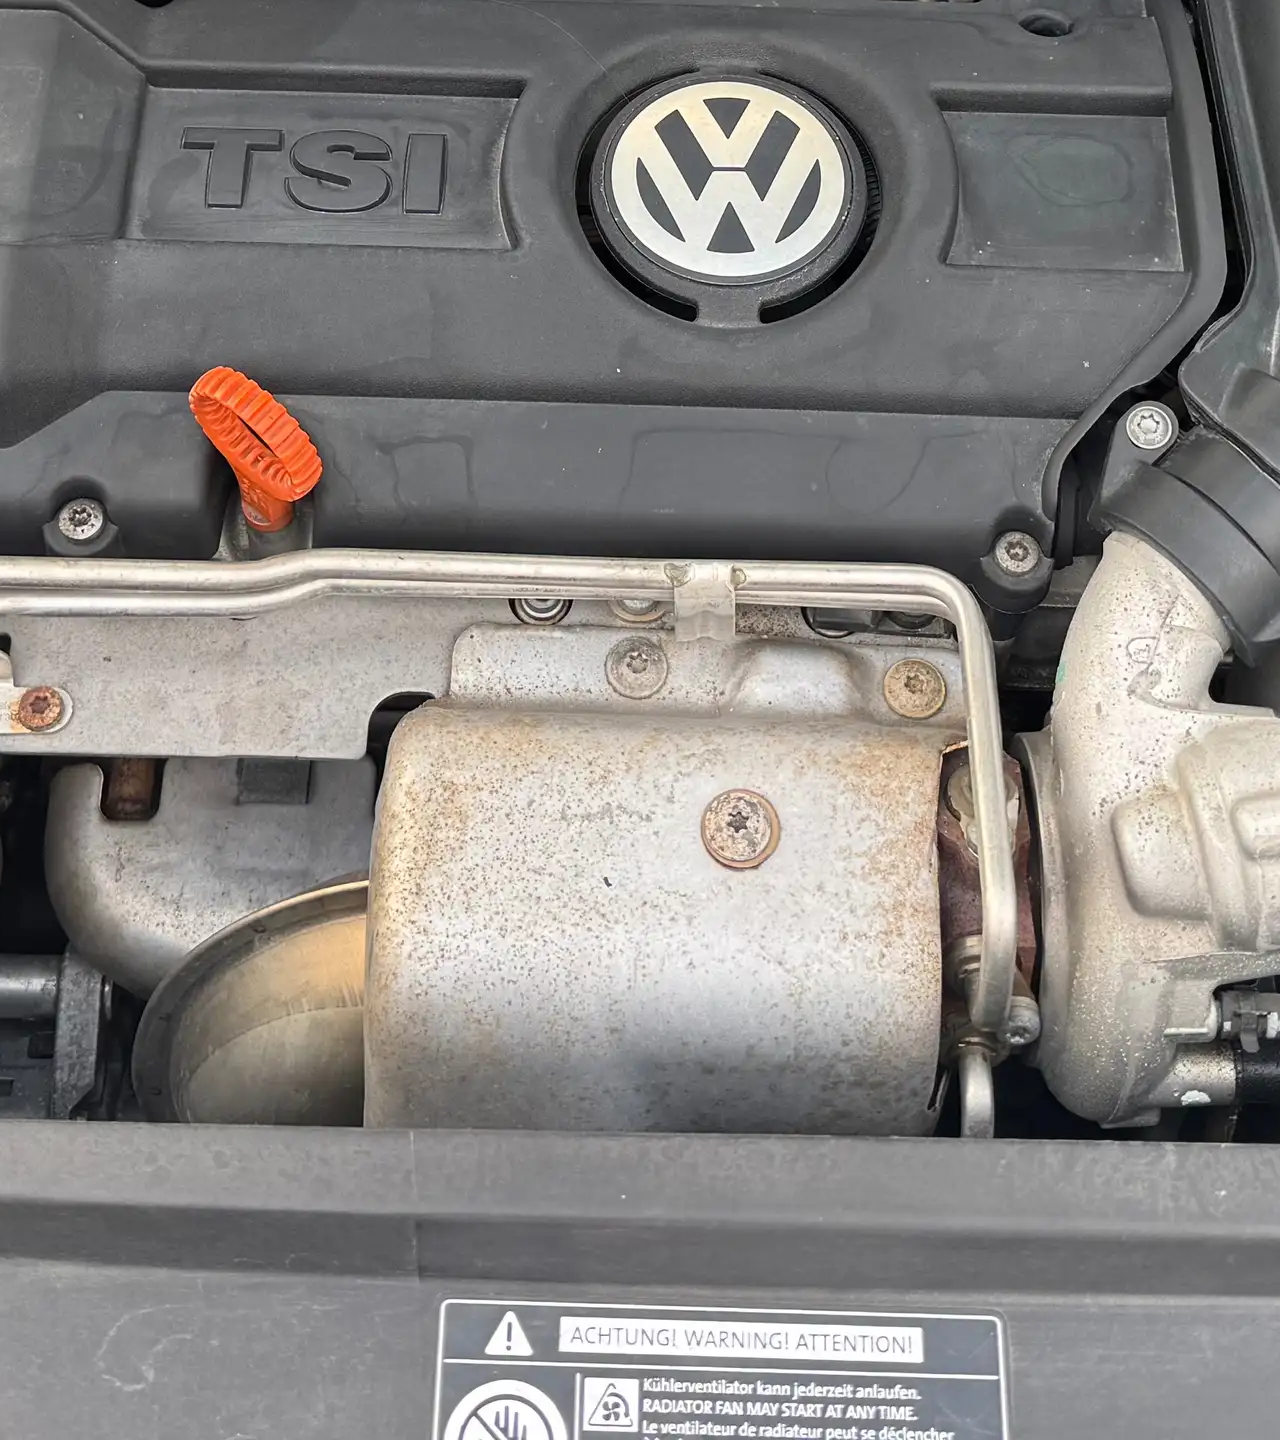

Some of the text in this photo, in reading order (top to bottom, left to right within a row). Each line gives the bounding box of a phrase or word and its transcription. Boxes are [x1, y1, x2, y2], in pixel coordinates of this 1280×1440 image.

[179, 125, 450, 216] TSI
[610, 80, 845, 277] VW
[570, 1326, 914, 1354] ACHTUNG! WARNING! ATTENTION!
[642, 1376, 923, 1401] Kühlerventilator kann jederzeit anlaufen.
[642, 1399, 919, 1421] RADIATOR FAN MAY START AT ANY TIME.
[641, 1420, 956, 1440] Le ventilateur de radiateur peut se déclencher
